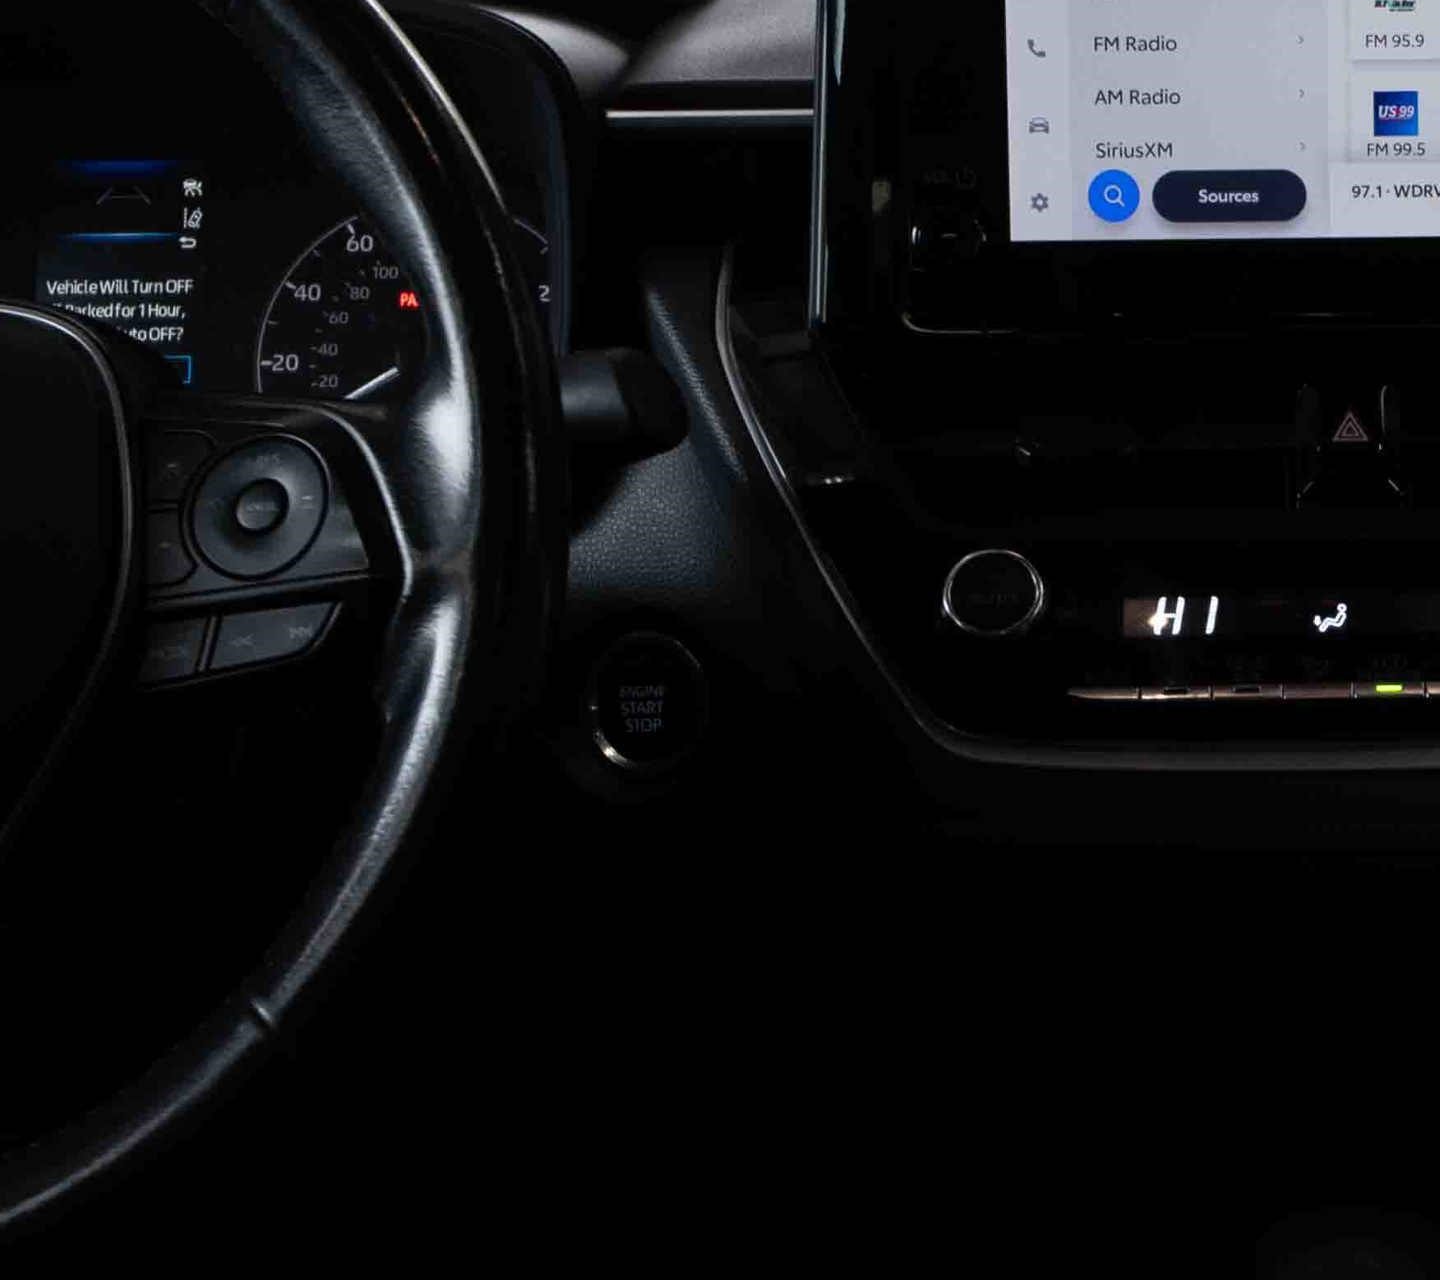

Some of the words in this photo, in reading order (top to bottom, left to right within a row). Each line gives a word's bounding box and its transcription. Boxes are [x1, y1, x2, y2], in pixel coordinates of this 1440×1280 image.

[1093, 36, 1120, 52] FM
[1125, 35, 1177, 52] Radio
[1365, 34, 1388, 49] FM
[1392, 33, 1425, 48] 95.9
[1094, 89, 1123, 105] AM
[1129, 88, 1181, 105] Radio
[1095, 141, 1174, 159] SiriusXM
[1366, 142, 1389, 157] FM
[1393, 142, 1426, 156] 99.5
[1198, 189, 1260, 204] Sources
[1351, 184, 1383, 199] 97.1
[345, 233, 375, 254] 60
[45, 278, 98, 296] Vehicle
[98, 278, 129, 295] Will
[131, 278, 164, 295] Turn
[165, 278, 195, 294] OFF
[293, 283, 323, 303] 40
[115, 302, 136, 318] for
[147, 303, 187, 320] Hour,
[148, 325, 185, 342] OFF?
[271, 352, 301, 372] 20
